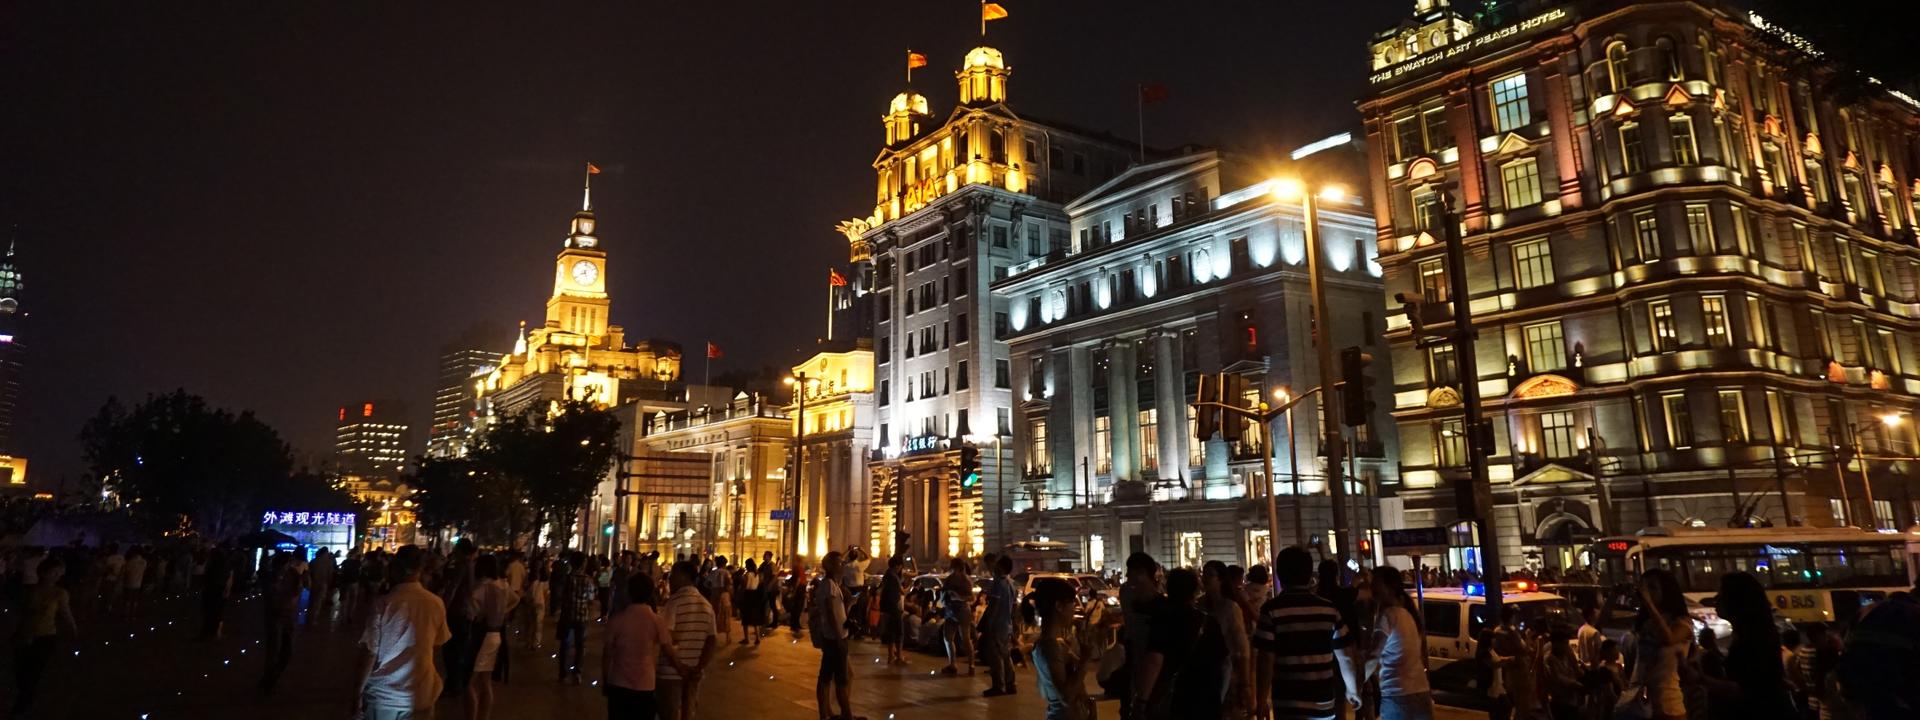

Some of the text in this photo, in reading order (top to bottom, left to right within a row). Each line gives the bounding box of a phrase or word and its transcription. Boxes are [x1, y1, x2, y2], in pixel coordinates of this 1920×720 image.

[1370, 8, 1566, 84] THE SWATCH ART PEACE HOTEL
[904, 178, 938, 212] AIA
[263, 511, 356, 525] 外滩观光隧道
[1791, 594, 1815, 609] BUS
